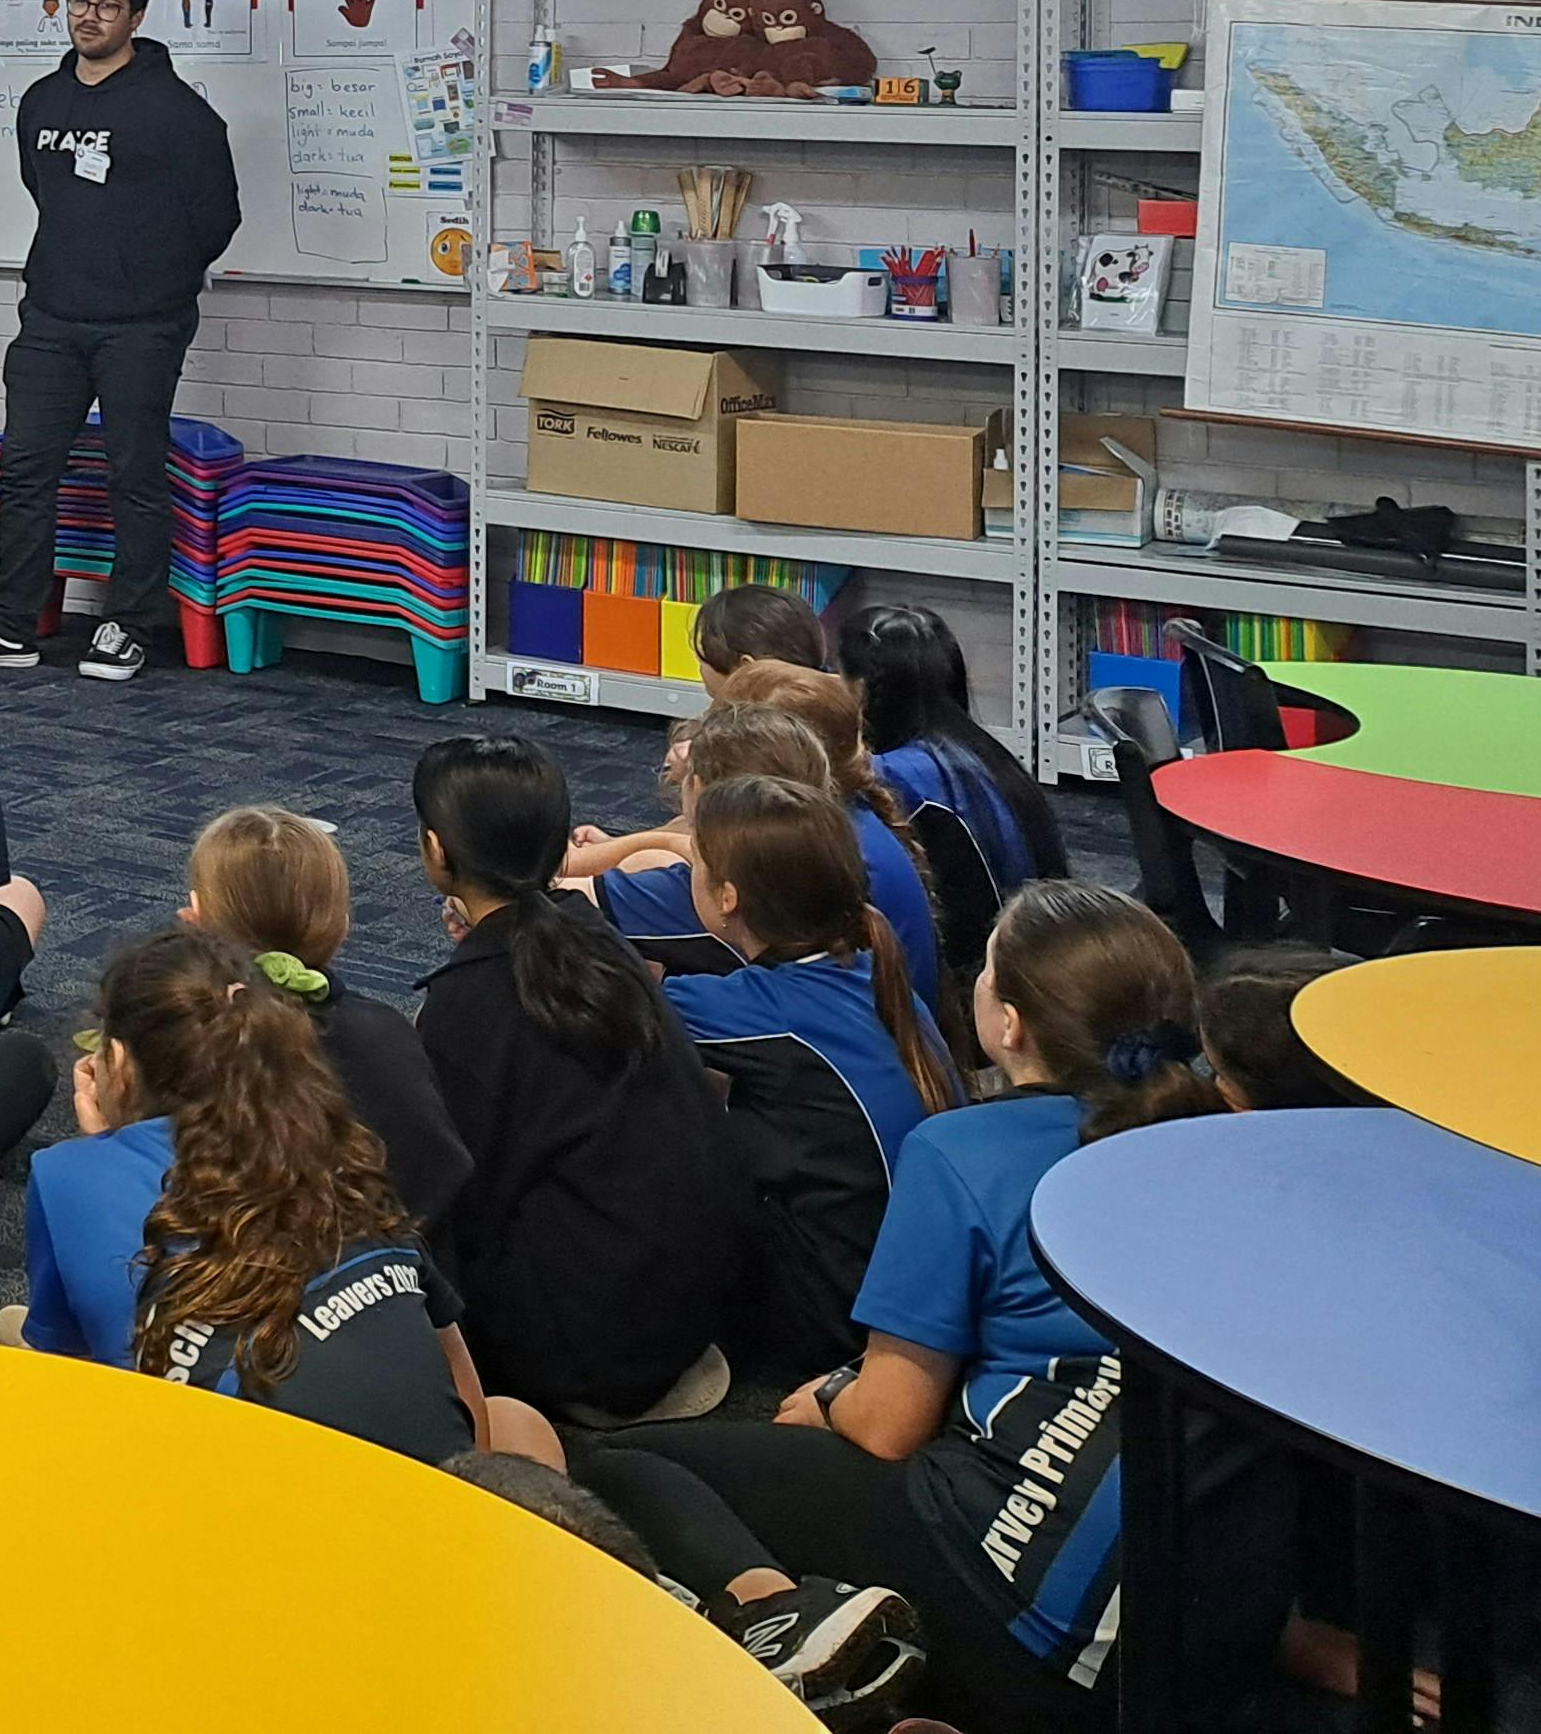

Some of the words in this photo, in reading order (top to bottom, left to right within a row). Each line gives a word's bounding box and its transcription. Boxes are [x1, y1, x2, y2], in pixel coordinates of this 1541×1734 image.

[167, 40, 194, 49] Sama
[196, 41, 221, 49] sama
[326, 39, 357, 48] Sampai
[290, 77, 313, 99] big
[331, 78, 377, 92] besar
[288, 100, 324, 119] small
[339, 103, 375, 117] kecil
[36, 129, 112, 152] PLACE
[291, 122, 319, 147] light
[336, 123, 375, 138] muda
[293, 147, 327, 164] dark
[337, 146, 364, 163] tua
[336, 202, 364, 217] tua
[720, 394, 778, 414] OfficeMax
[538, 416, 574, 432] TORK
[586, 426, 643, 445] Fellowes
[537, 679, 567, 691] Room
[297, 1272, 394, 1343] Leavers
